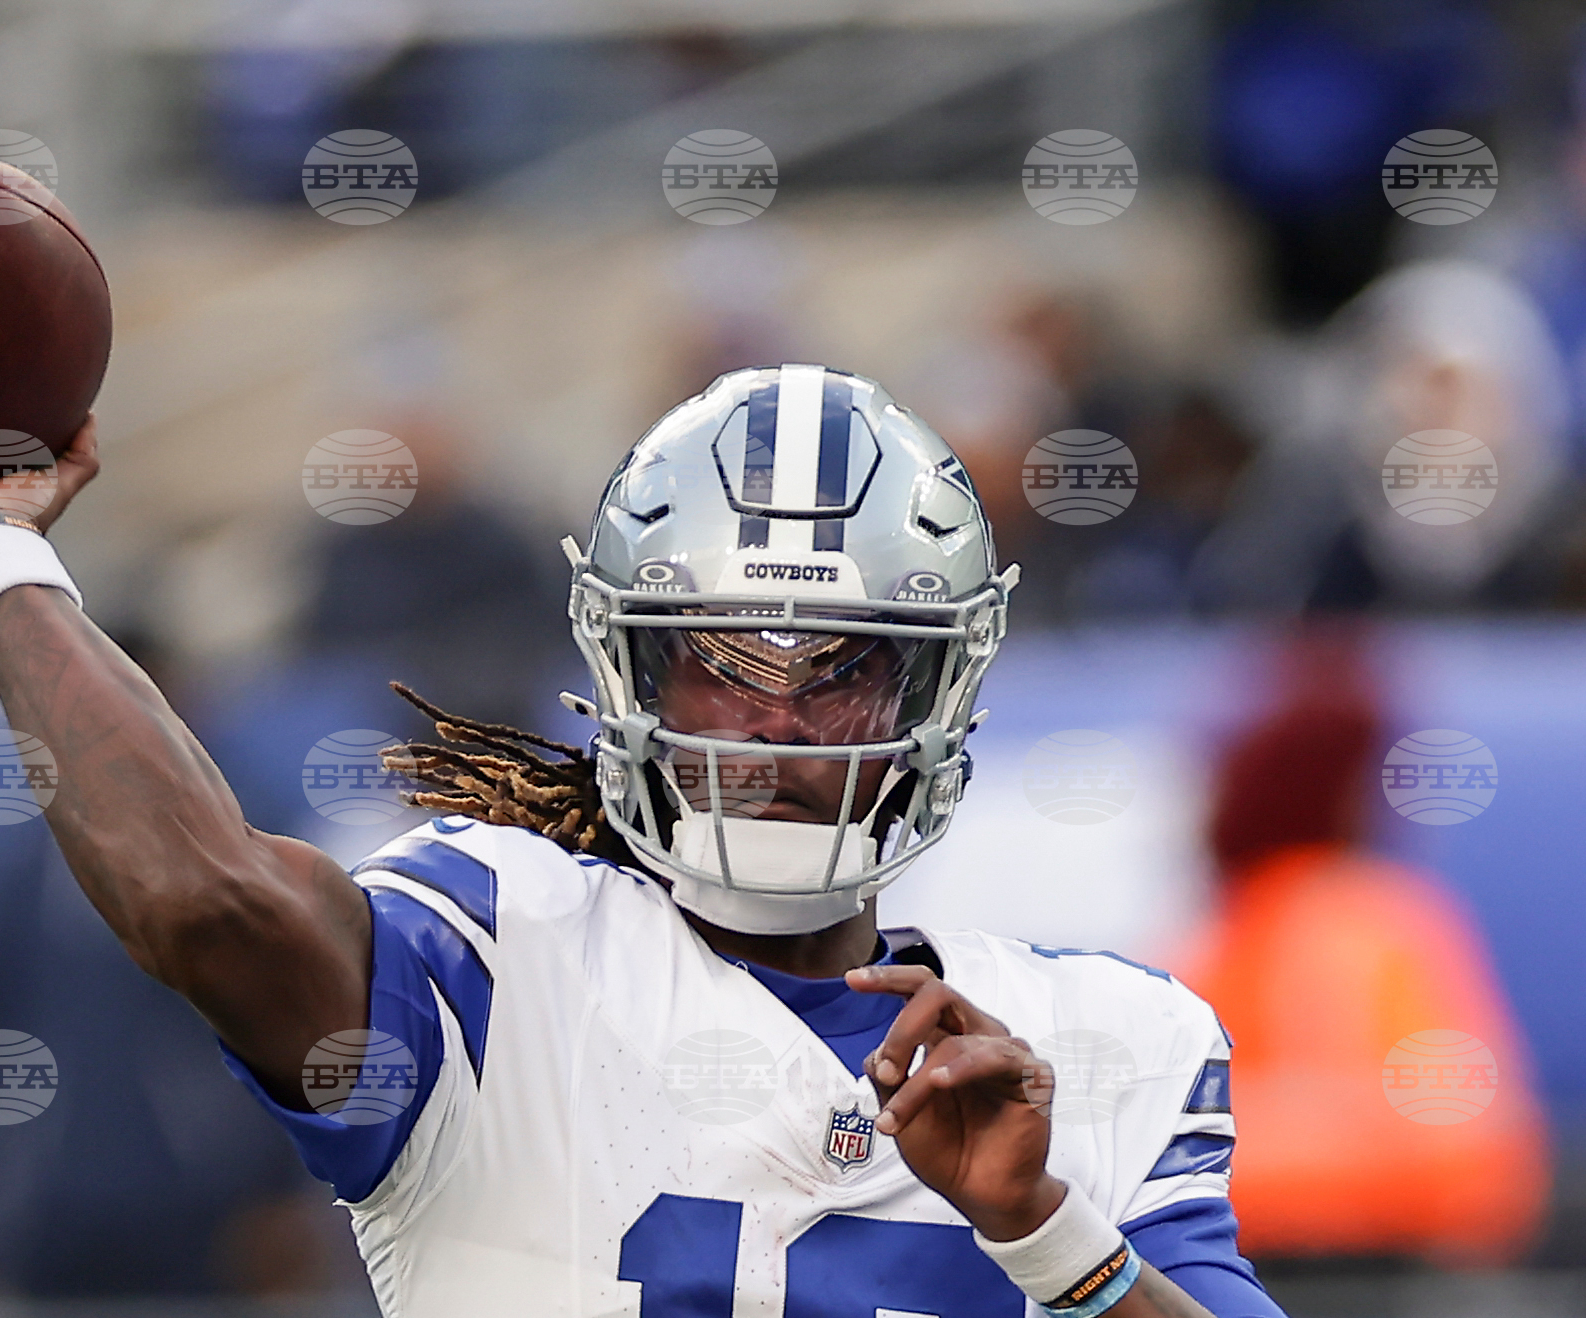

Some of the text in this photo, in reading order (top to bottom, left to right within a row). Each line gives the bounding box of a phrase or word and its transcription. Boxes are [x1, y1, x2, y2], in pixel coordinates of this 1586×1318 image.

[744, 563, 839, 583] COWBOYS
[831, 1131, 865, 1160] NFL
[1071, 1265, 1112, 1302] RIGHT
